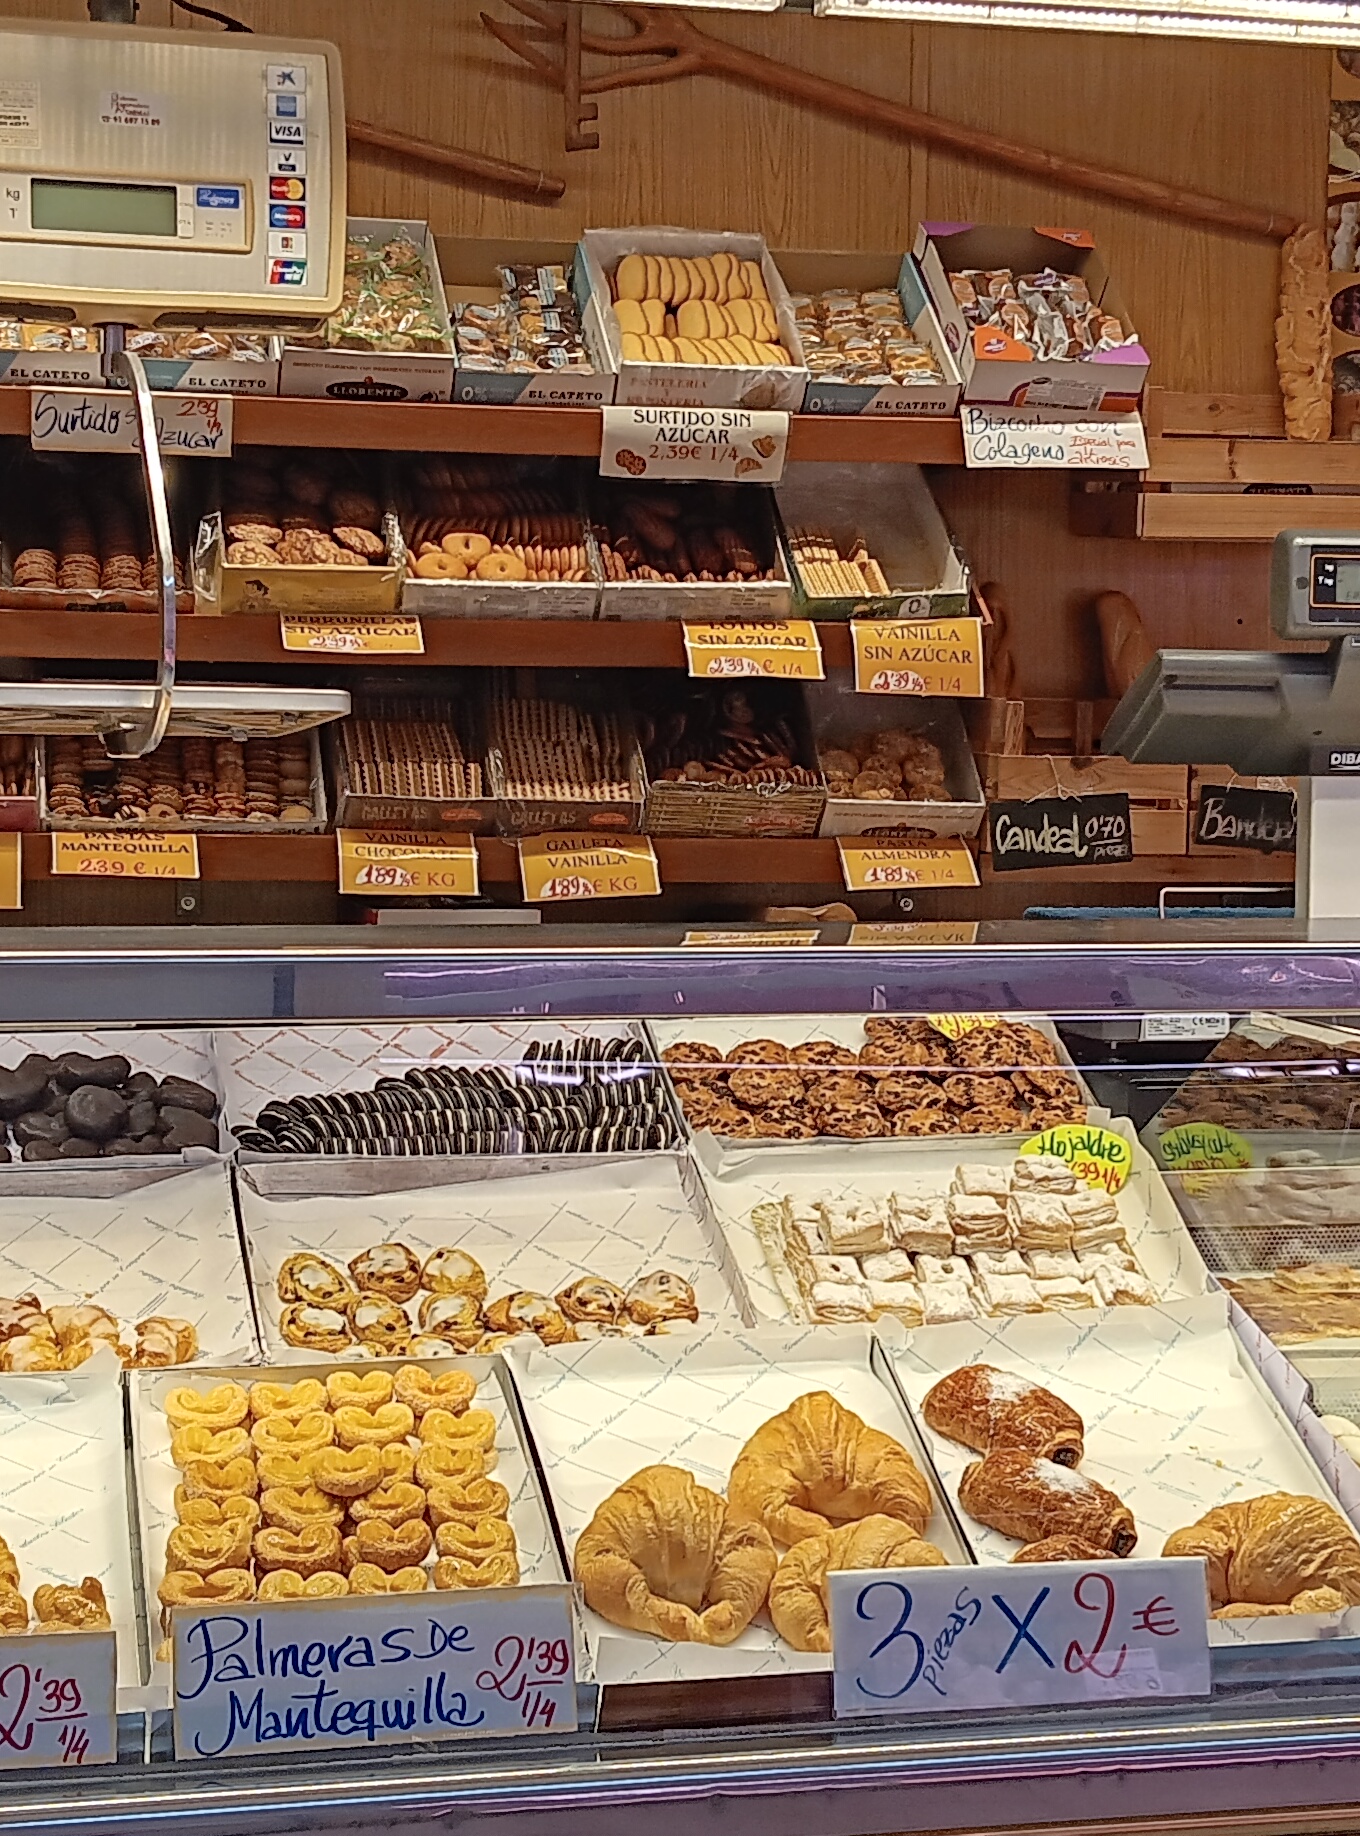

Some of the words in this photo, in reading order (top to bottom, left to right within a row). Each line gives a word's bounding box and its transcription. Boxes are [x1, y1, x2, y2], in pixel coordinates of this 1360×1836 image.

[275, 125, 301, 137] VISA
[6, 187, 20, 201] kg
[10, 368, 29, 378] EL
[33, 369, 90, 380] CATETO
[189, 378, 206, 387] EL
[210, 378, 267, 388] CATETO
[528, 390, 545, 399] EL
[549, 391, 603, 400] CATETO
[875, 401, 892, 409] EL
[895, 402, 947, 410] CATETO
[633, 409, 715, 427] SURTIDO
[721, 413, 752, 427] SIN
[655, 424, 730, 444] AZÚCAR
[711, 446, 739, 463] 1/4
[698, 635, 727, 645] SIN
[874, 627, 961, 641] VAINILLA
[864, 646, 893, 659] SIN
[899, 644, 973, 664] AZÚCAR
[940, 677, 961, 692] 1/4
[365, 833, 446, 845] VAINILLA
[995, 813, 1088, 858] Candeal
[1085, 814, 1127, 837] 0'70
[61, 843, 191, 854] MANTEQUILLA
[547, 838, 624, 851] GALLETA
[547, 854, 628, 868] VAINILLA
[861, 850, 952, 861] ALMENDRA
[154, 865, 176, 875] 1/4
[932, 869, 955, 880] 1/4
[427, 873, 455, 887] KG
[610, 876, 638, 892] KG
[856, 1581, 924, 1699] 3
[1064, 1572, 1127, 1679] 2
[1132, 1596, 1180, 1636] €
[177, 1616, 414, 1700] Palmeras
[476, 1635, 570, 1700] 2'39
[194, 1672, 485, 1756] Mantequilla
[521, 1691, 556, 1727] 1/4
[57, 1725, 89, 1764] 1/4
